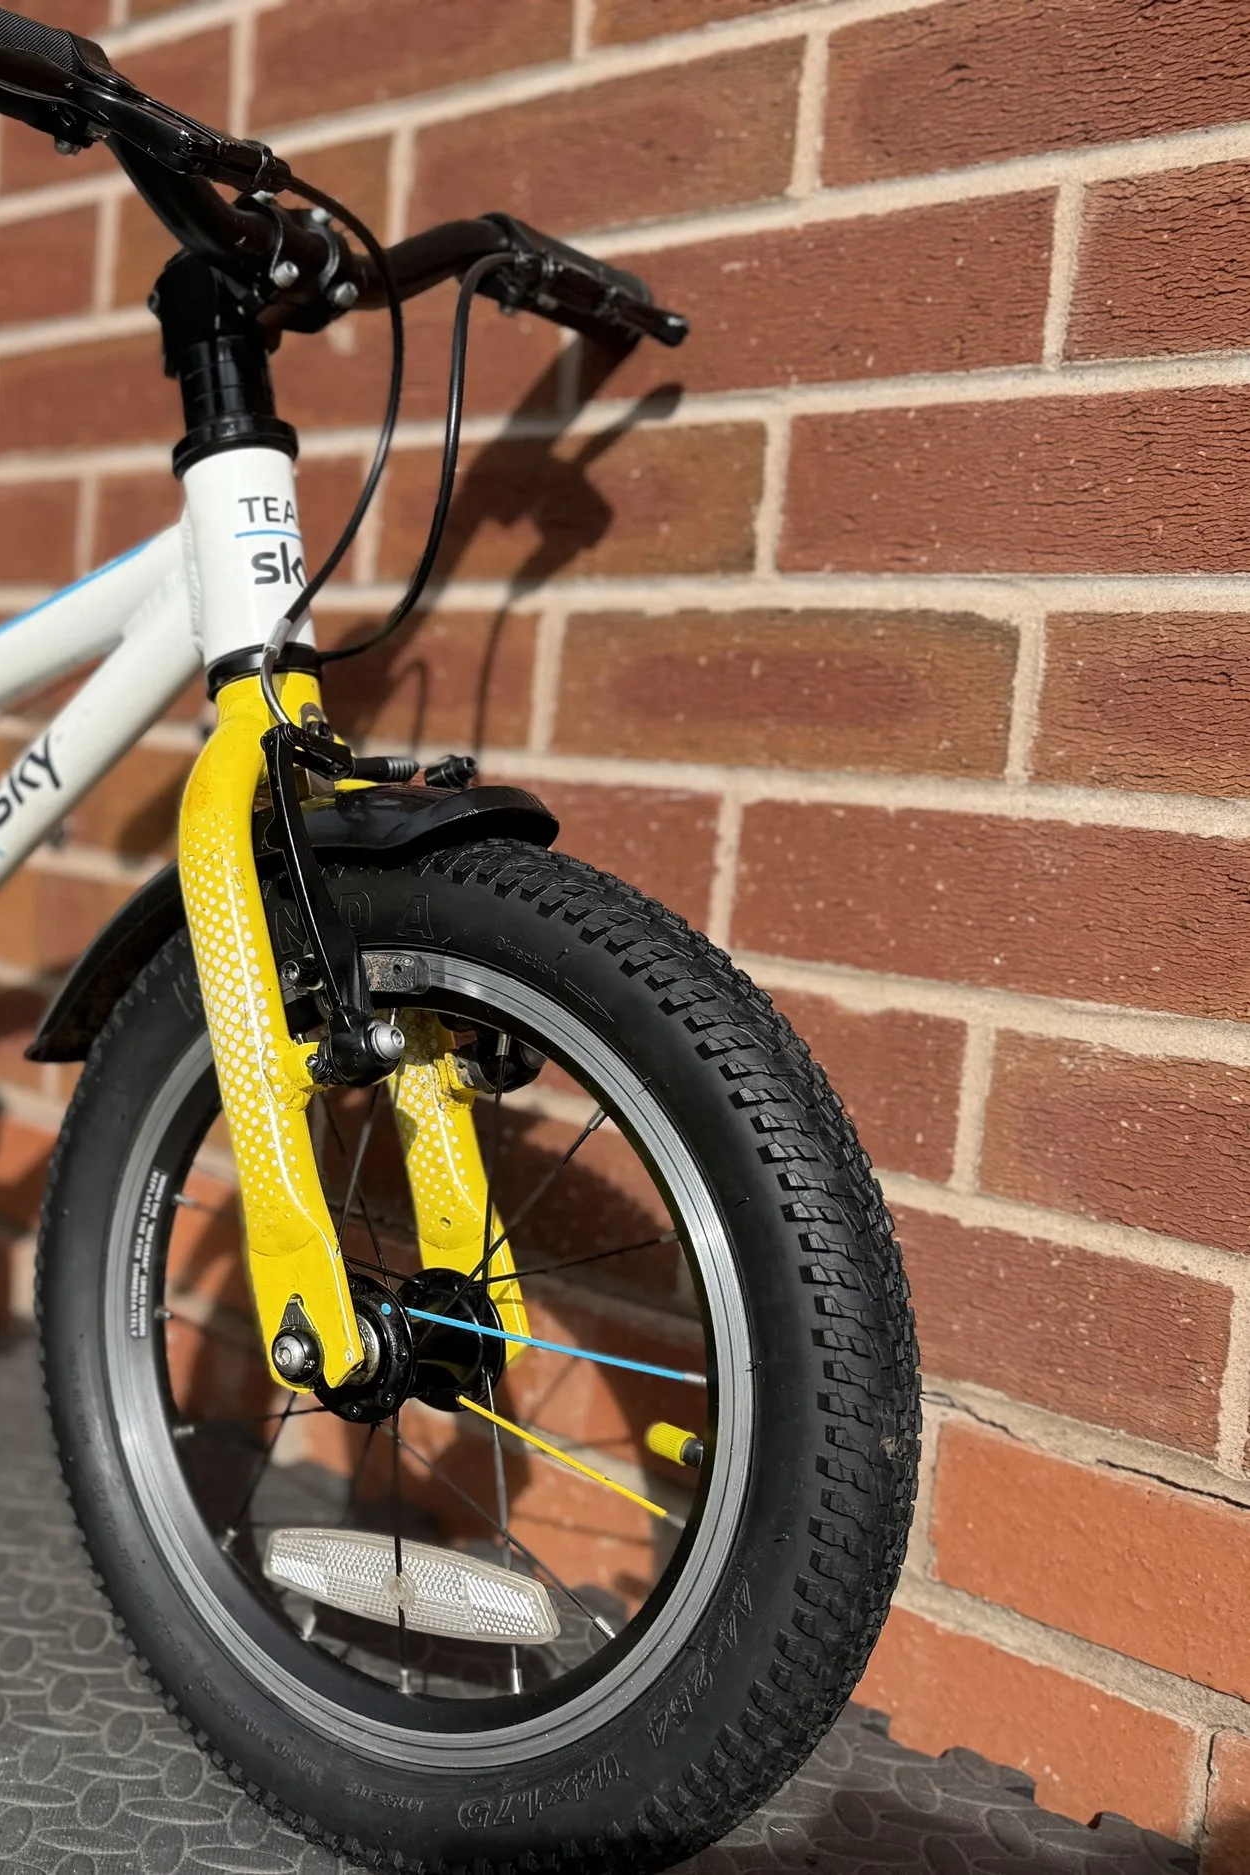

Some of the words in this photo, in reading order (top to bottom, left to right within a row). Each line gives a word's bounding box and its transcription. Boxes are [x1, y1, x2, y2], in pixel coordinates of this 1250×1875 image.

[237, 495, 299, 526] TEA
[250, 541, 308, 590] sk
[495, 935, 559, 983] Direction
[142, 1170, 160, 1214] REPLACE
